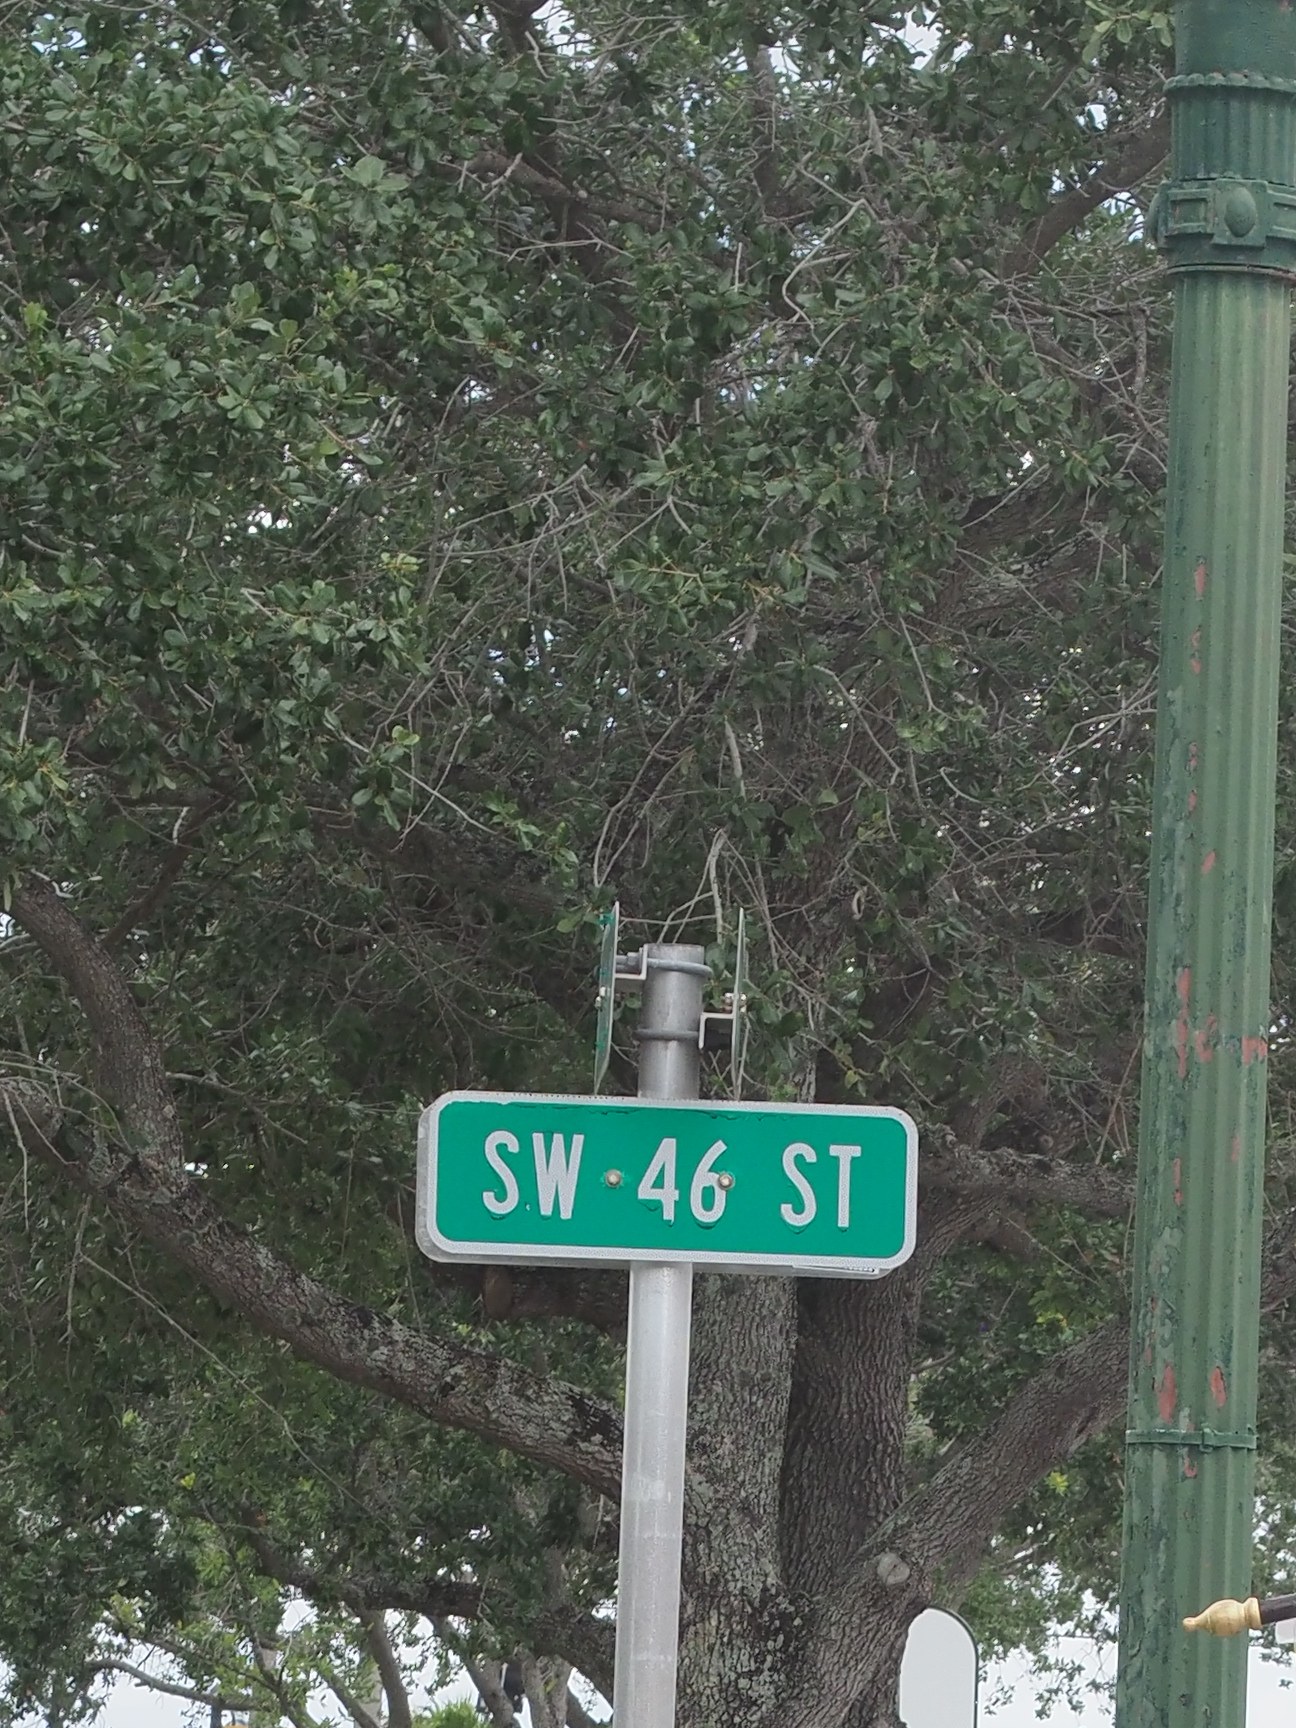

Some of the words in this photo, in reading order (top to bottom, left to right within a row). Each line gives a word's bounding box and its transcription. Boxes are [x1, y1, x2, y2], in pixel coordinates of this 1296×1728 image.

[482, 1130, 584, 1220] SW
[637, 1138, 727, 1224] 46
[780, 1142, 861, 1228] ST
